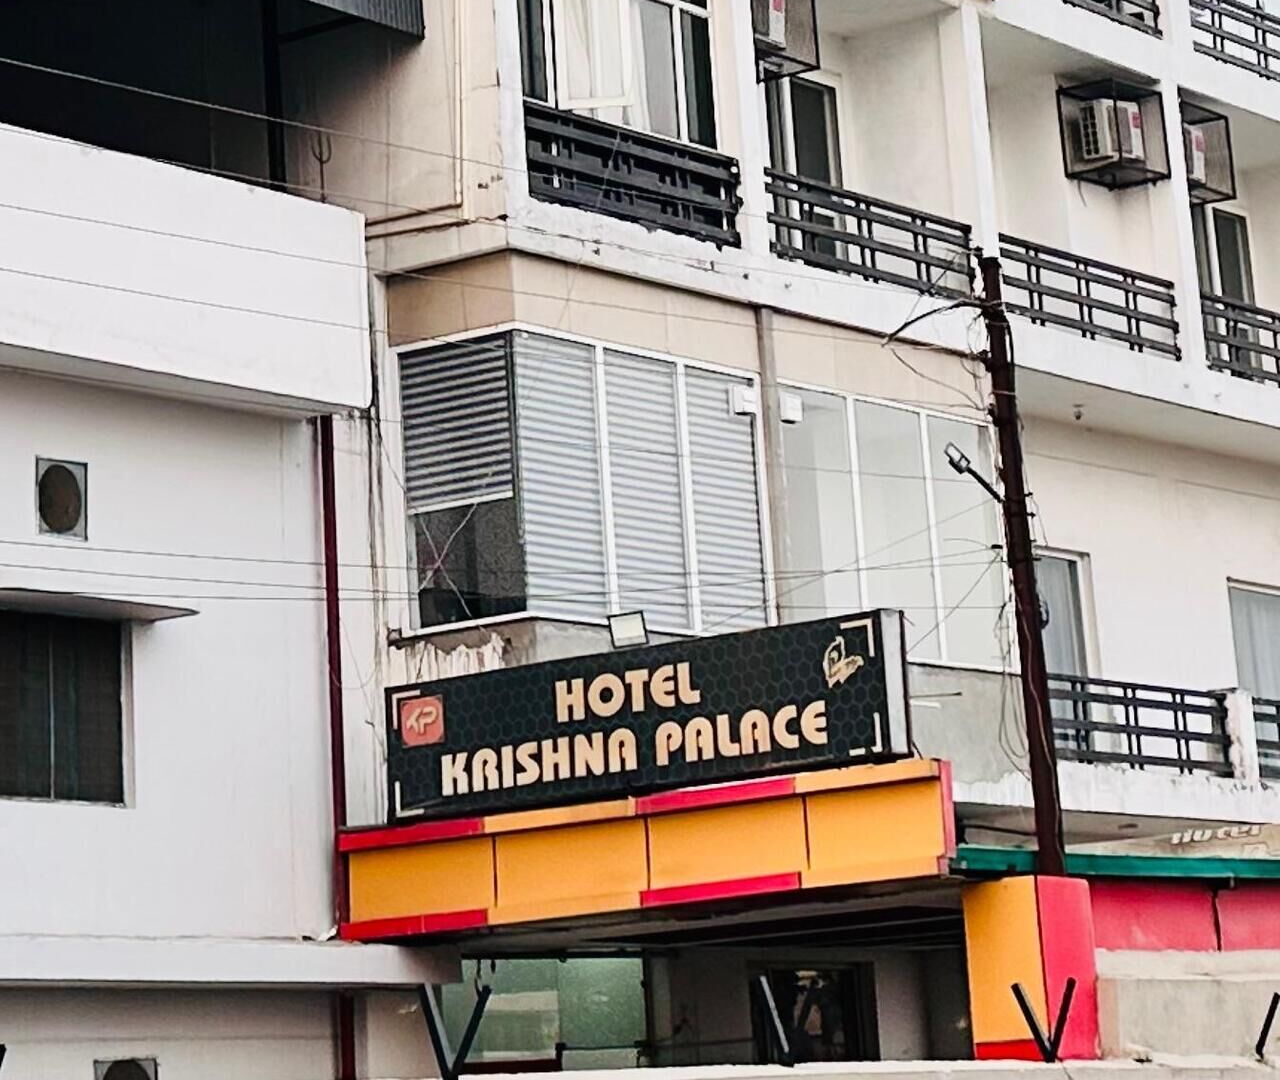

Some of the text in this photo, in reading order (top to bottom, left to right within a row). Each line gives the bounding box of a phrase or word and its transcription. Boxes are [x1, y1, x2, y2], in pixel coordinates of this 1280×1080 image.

[554, 661, 701, 723] HOTEL
[441, 700, 829, 797] KRISHNA PALACE
